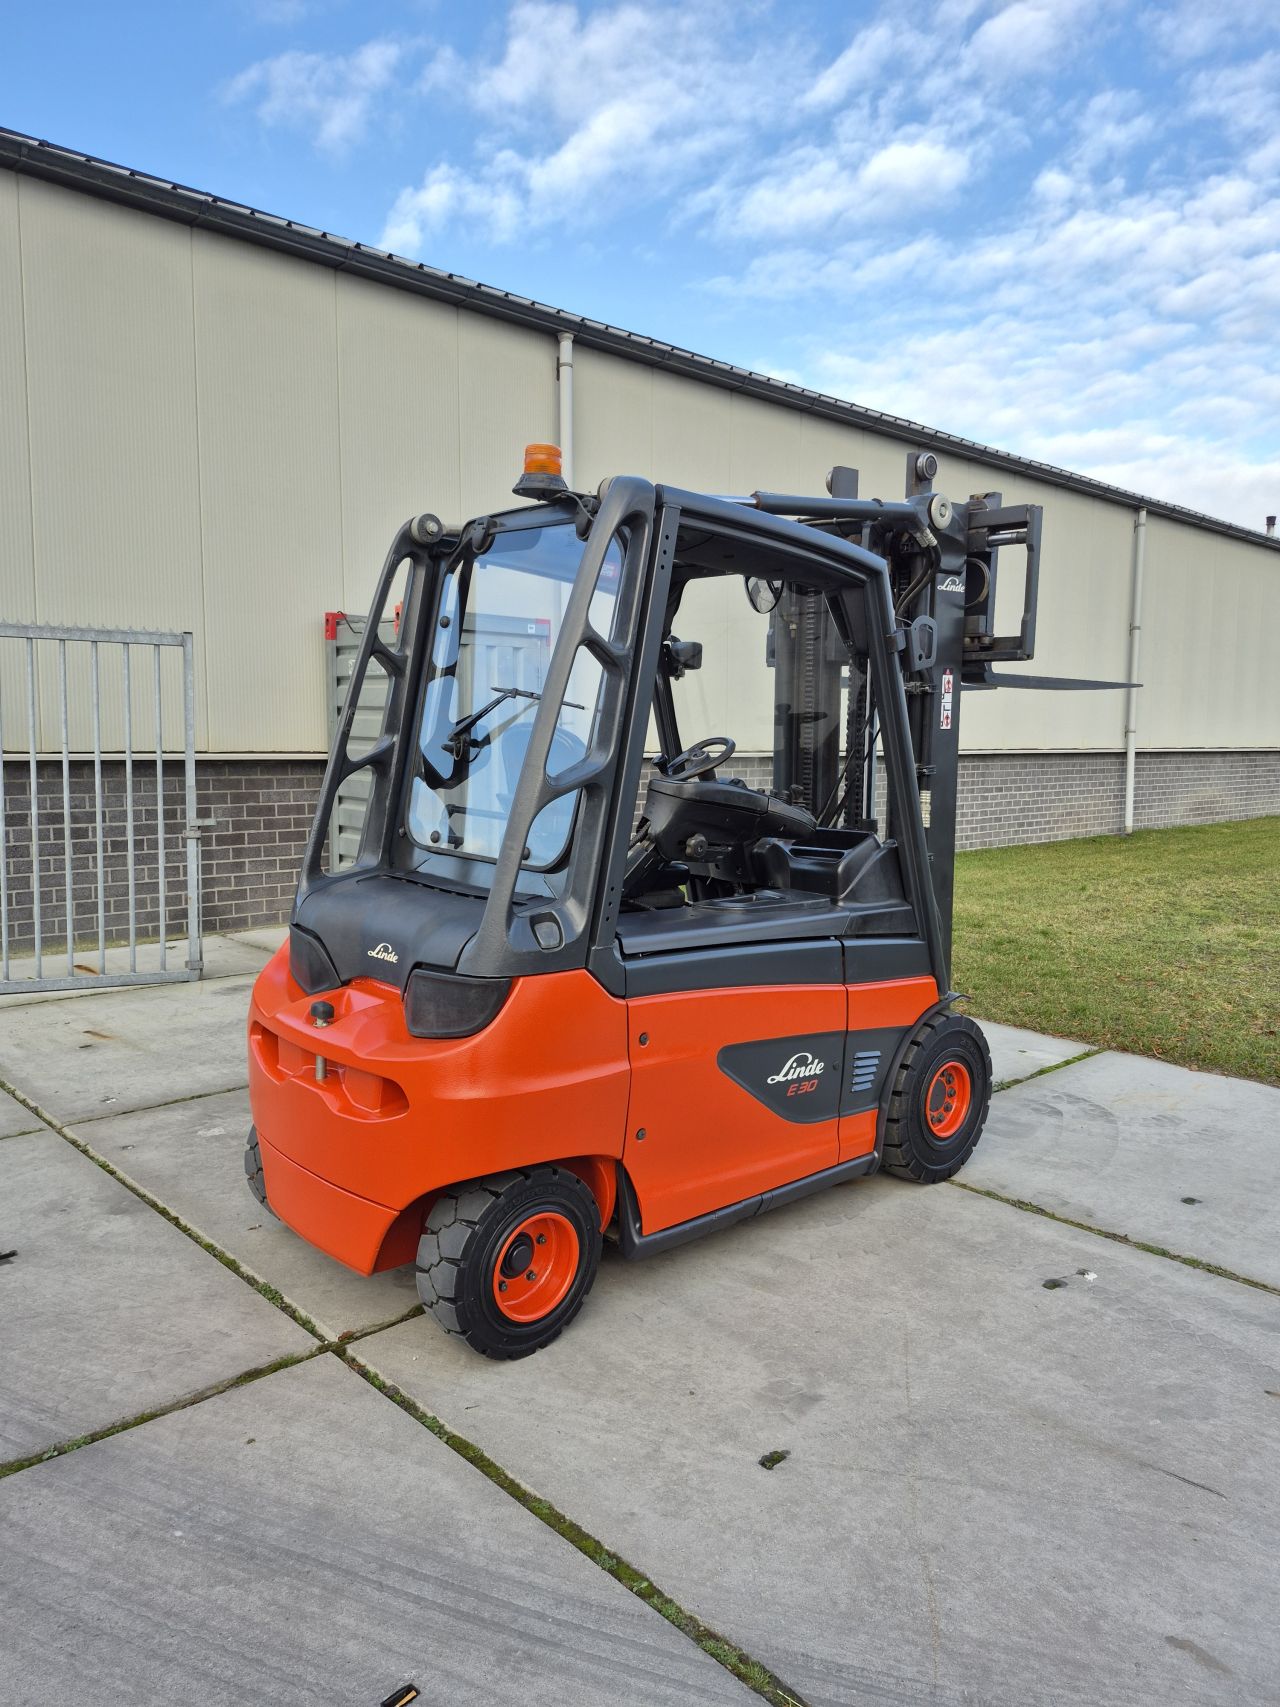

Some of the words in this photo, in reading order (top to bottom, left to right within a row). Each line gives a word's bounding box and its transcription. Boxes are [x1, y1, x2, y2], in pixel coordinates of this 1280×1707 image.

[937, 576, 966, 593] Linde
[367, 942, 399, 963] Linde
[766, 1052, 825, 1084] Linde
